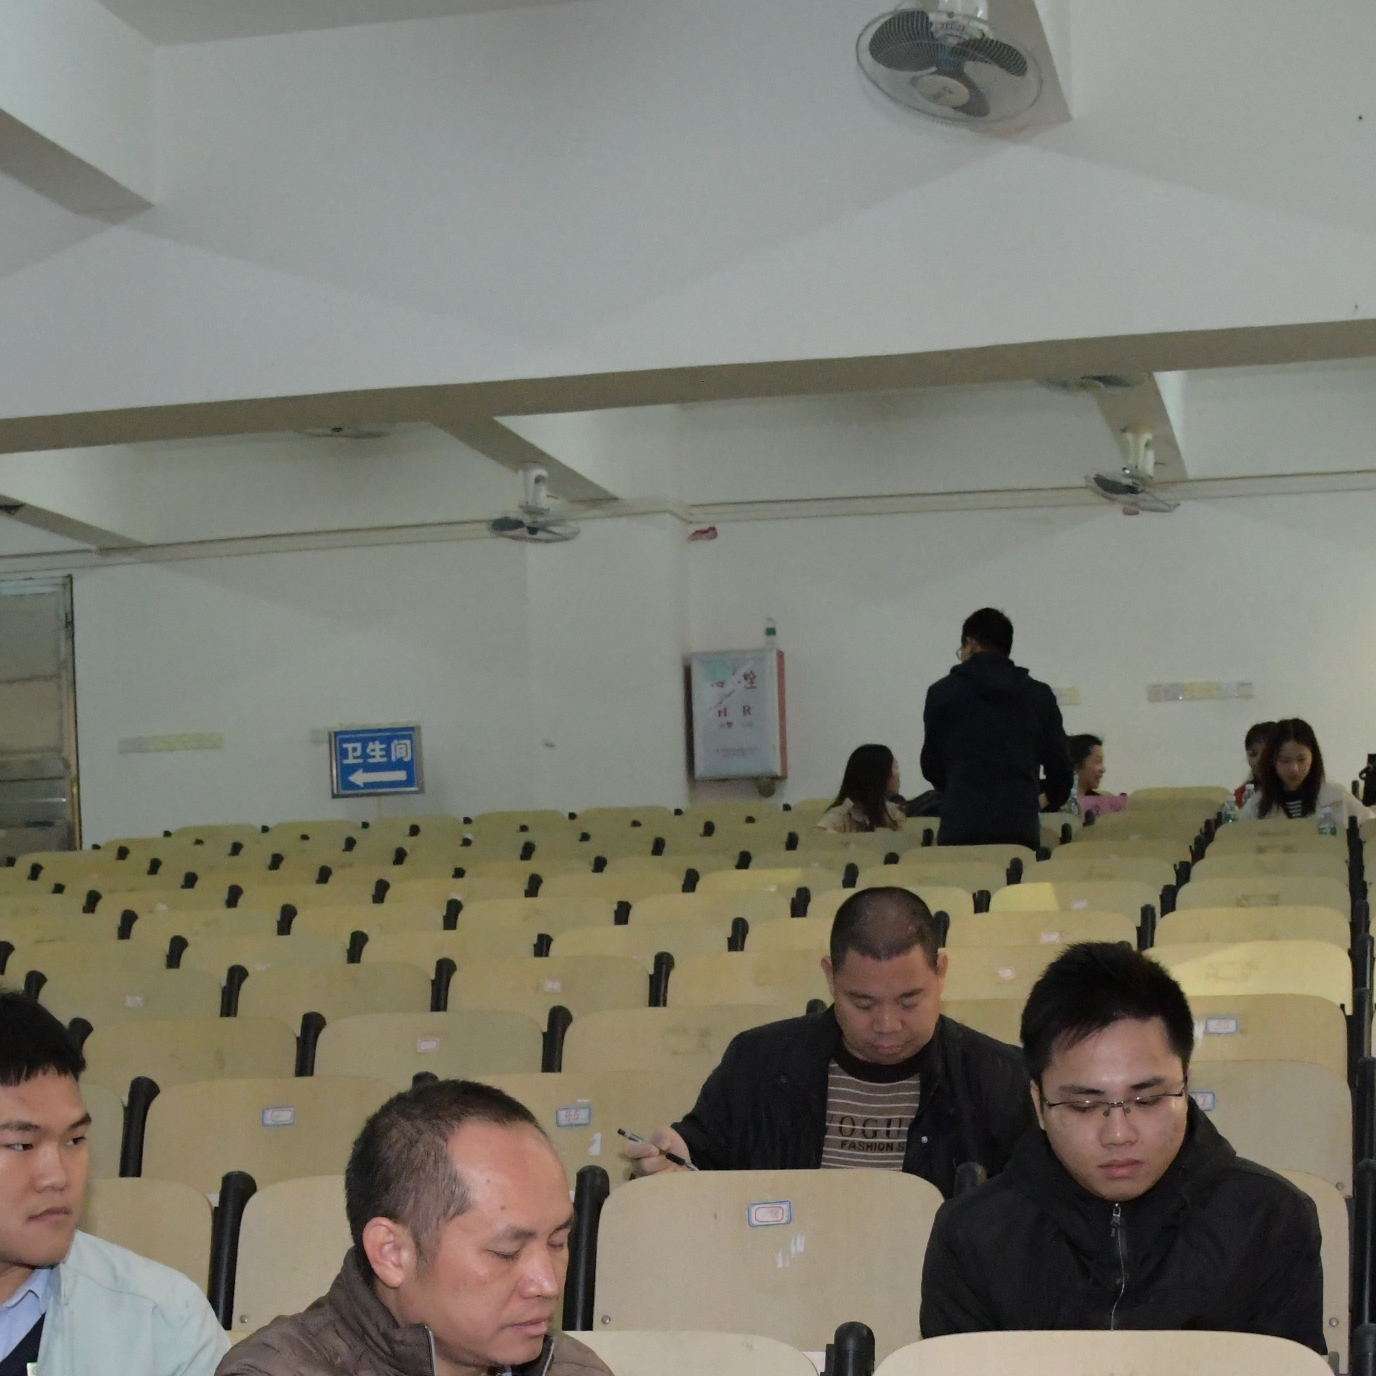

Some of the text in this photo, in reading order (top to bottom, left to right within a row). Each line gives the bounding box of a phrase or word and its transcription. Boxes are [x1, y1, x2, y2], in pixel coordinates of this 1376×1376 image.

[342, 740, 412, 764] 卫生间
[565, 1109, 581, 1121] 45
[840, 1141, 893, 1152] FASHION
